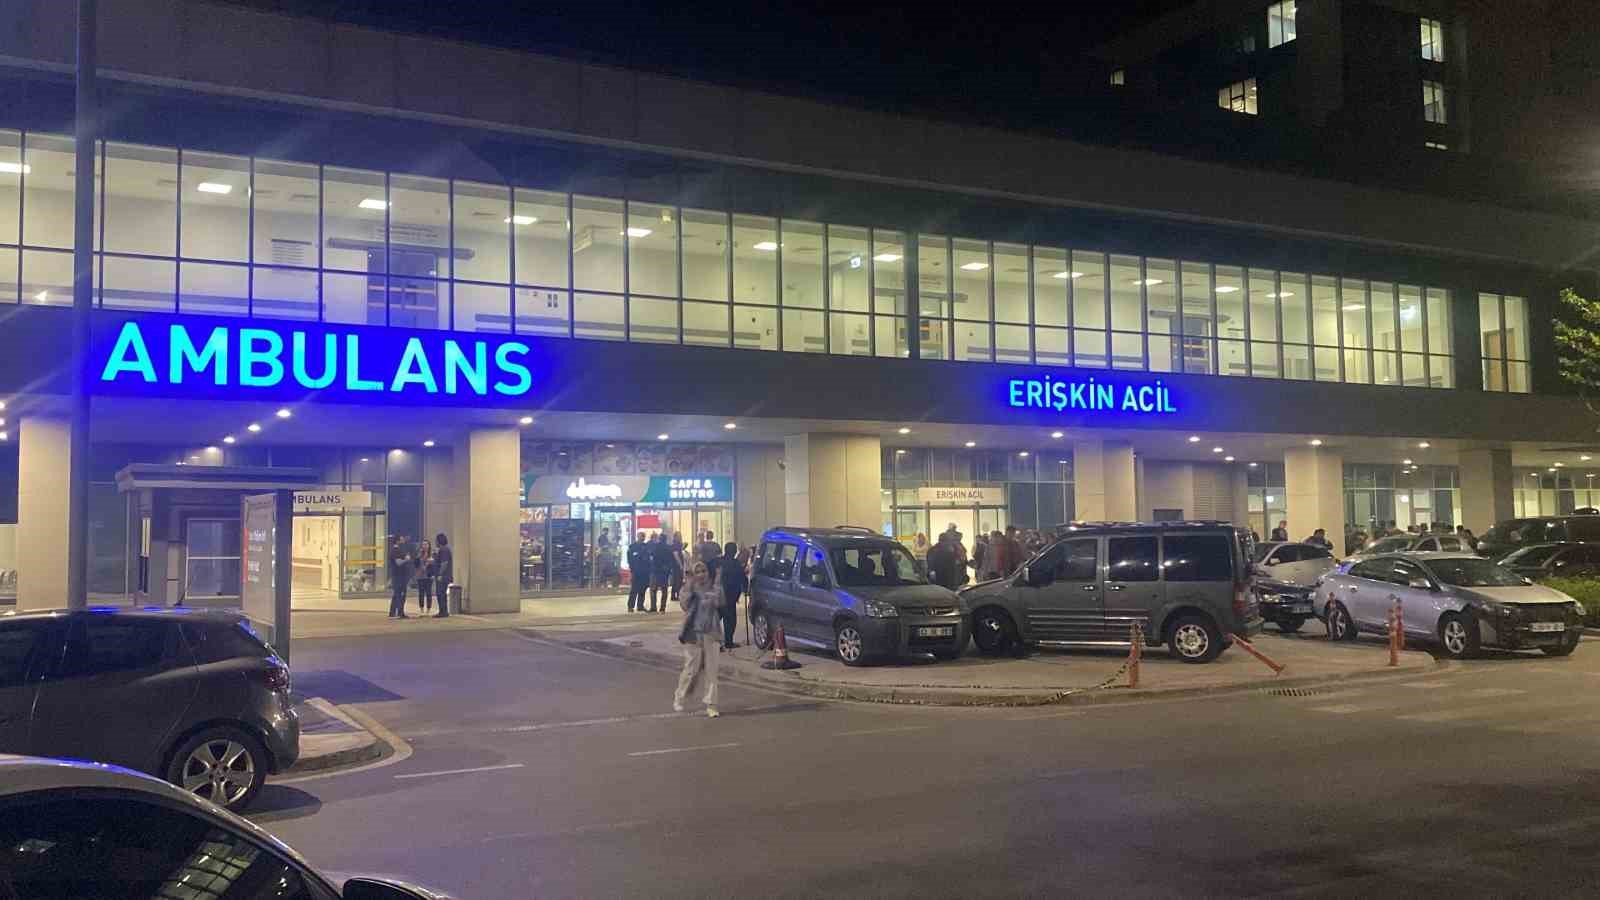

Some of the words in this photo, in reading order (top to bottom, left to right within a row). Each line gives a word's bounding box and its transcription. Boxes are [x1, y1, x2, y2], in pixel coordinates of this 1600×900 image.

[101, 322, 532, 395] AMBULANS
[1009, 375, 1114, 411] ERİŞKİN
[1122, 380, 1177, 412] ACİL
